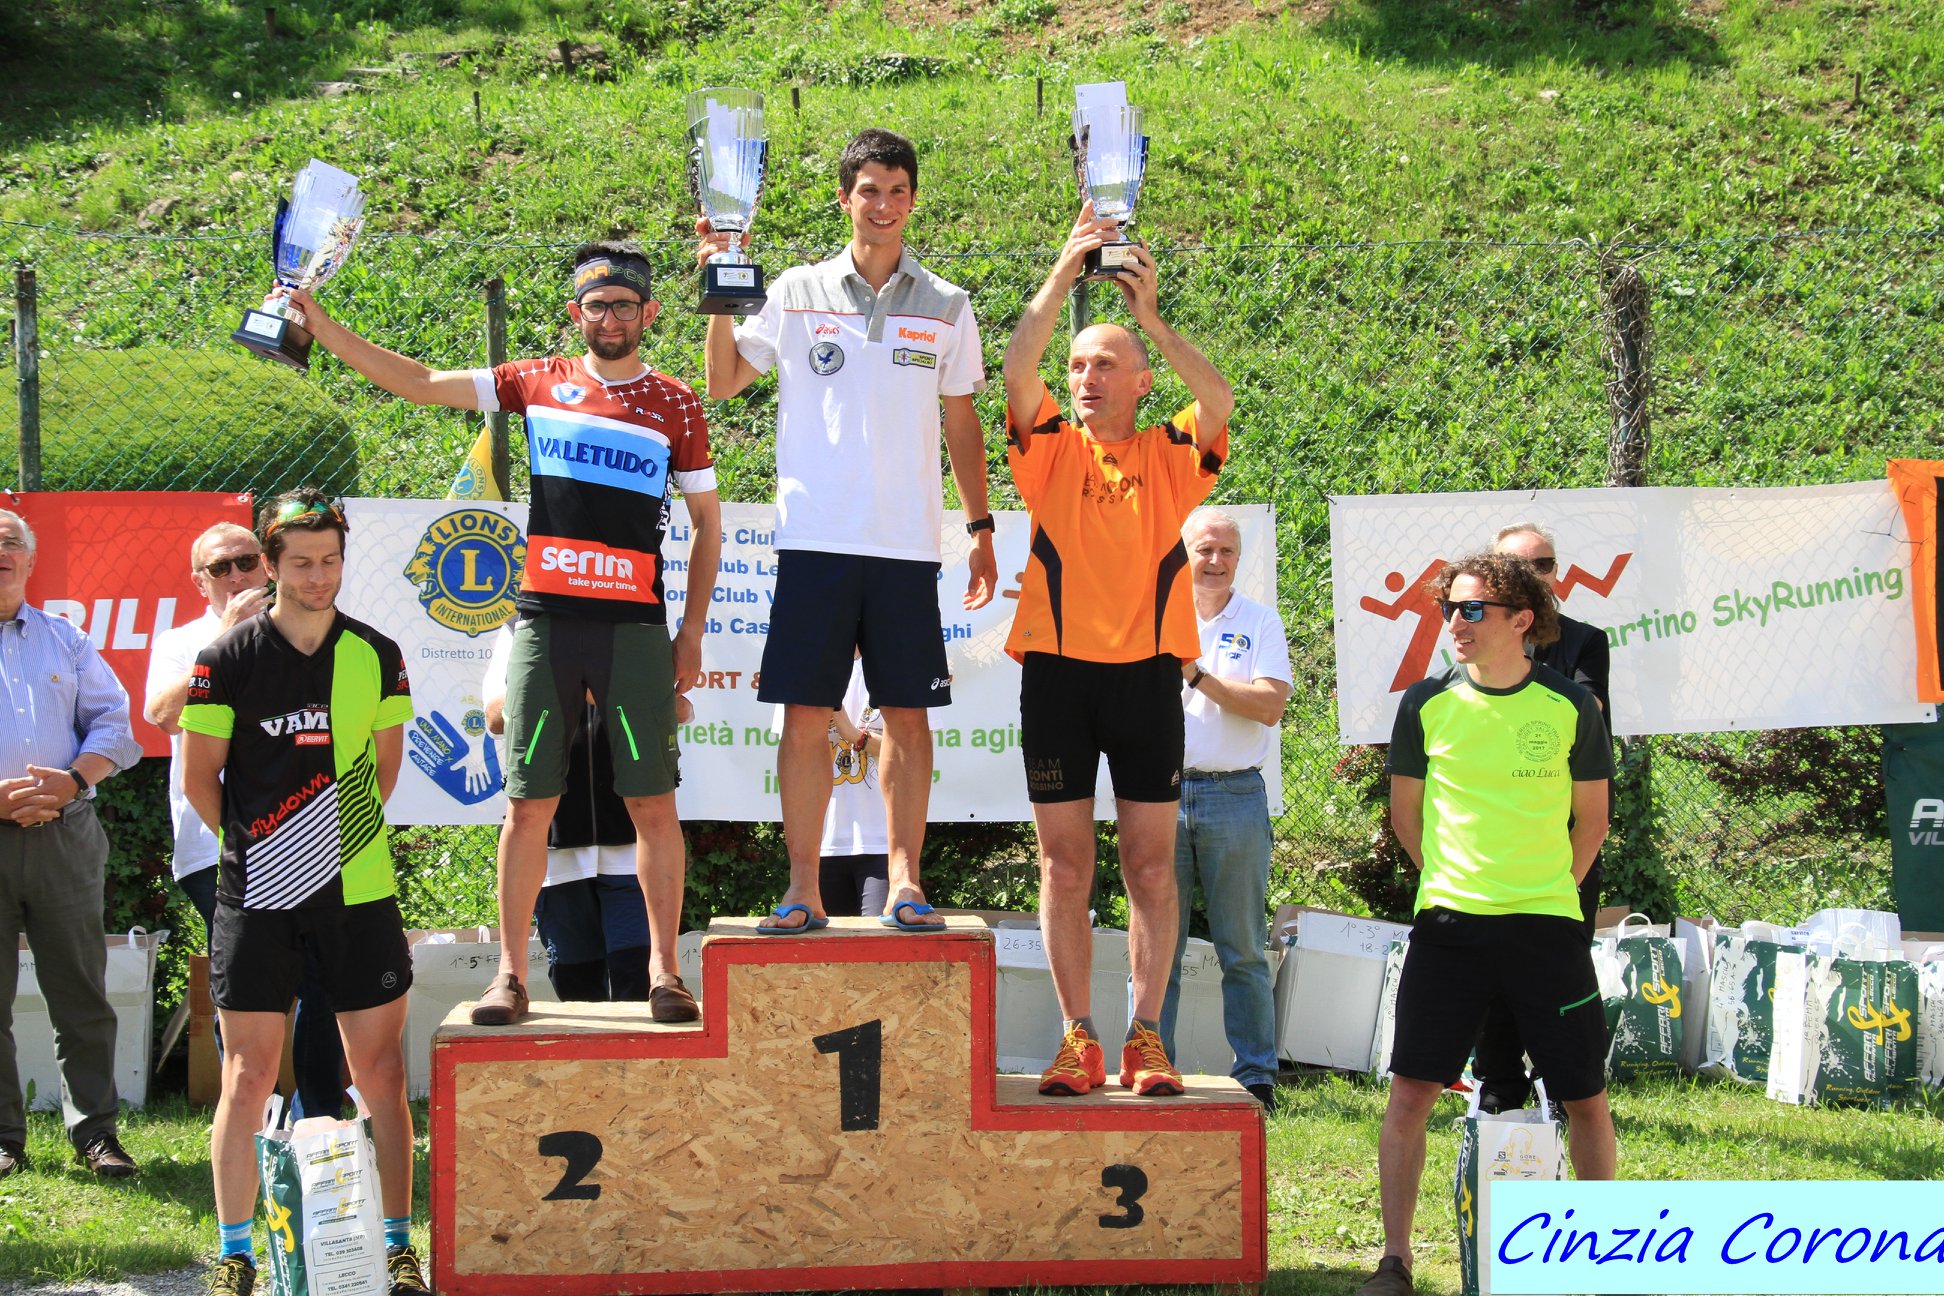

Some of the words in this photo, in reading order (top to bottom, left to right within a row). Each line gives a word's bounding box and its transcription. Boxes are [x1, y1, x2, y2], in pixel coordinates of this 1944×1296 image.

[898, 327, 937, 344] Kapriol
[537, 436, 659, 479] VALETUDO
[435, 514, 513, 543] LIONS
[735, 529, 776, 546] Clu
[459, 549, 494, 591] L
[540, 546, 633, 580] serim
[568, 576, 590, 587] take
[591, 579, 615, 590] your
[615, 581, 637, 592] time
[711, 587, 759, 604] Club
[434, 603, 513, 627] INTERNATIONAL
[1604, 608, 1697, 649] artino
[1711, 566, 1904, 628] SkyRunning
[941, 623, 972, 643] ghi
[421, 647, 475, 660] Distretto
[695, 671, 742, 690] ORT
[259, 711, 329, 737] VAM
[677, 720, 734, 746] rietà
[744, 725, 781, 747] no
[1511, 766, 1535, 778] ciao
[249, 772, 331, 838] flydown
[1908, 831, 1944, 846] VIL
[1649, 942, 1661, 993] SPORT
[1858, 967, 1869, 1019] SPORT
[1882, 966, 1892, 1016] SPORT
[1656, 1004, 1669, 1055] AFFARI
[1863, 1030, 1874, 1083] AFFARI
[812, 1018, 882, 1132] 1
[537, 1130, 604, 1202] 2
[1098, 1163, 1149, 1229] 3
[320, 1237, 353, 1247] VILLASANTA
[337, 1271, 357, 1279] LECCO
